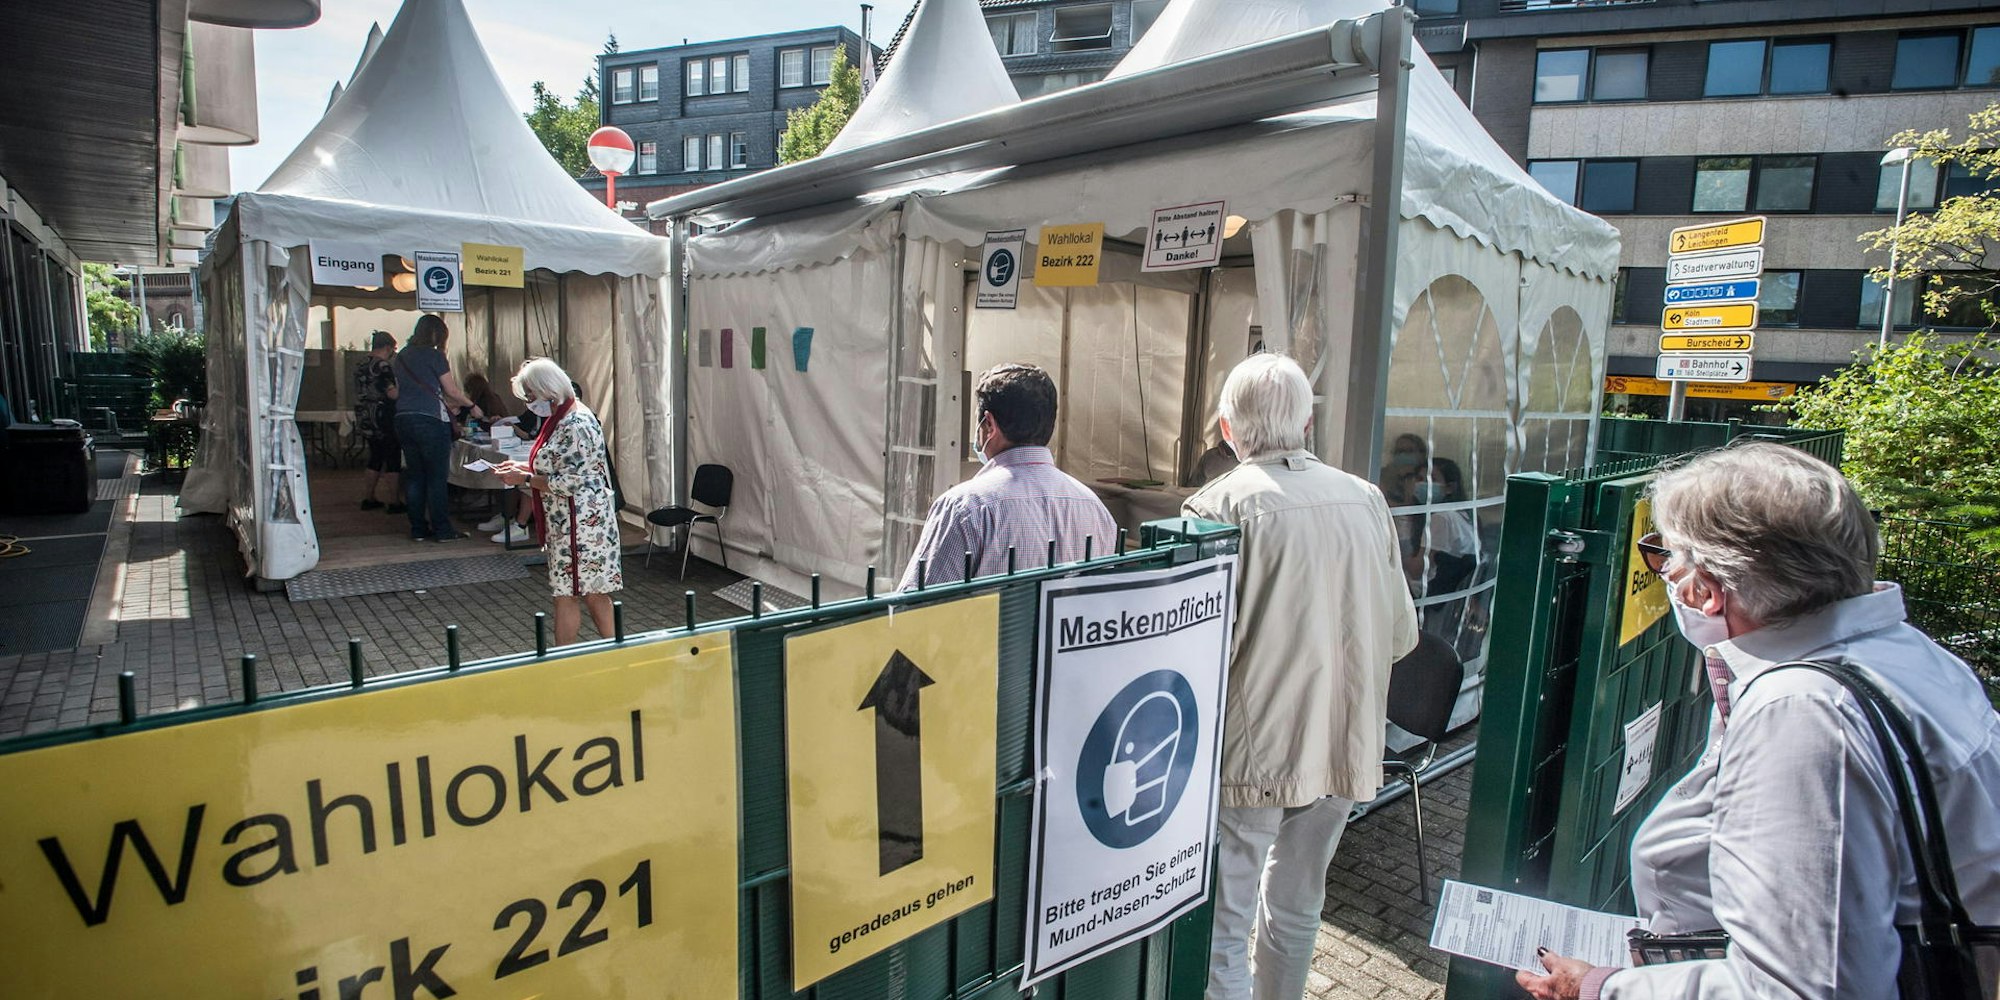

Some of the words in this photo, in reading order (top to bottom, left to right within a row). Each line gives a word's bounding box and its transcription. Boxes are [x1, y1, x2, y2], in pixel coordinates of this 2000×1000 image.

[1173, 212, 1198, 220] Abstand
[1199, 209, 1219, 217] halten
[1048, 232, 1094, 245] Wahllokal
[1689, 228, 1728, 239] Langenfeld
[1688, 238, 1728, 248] Leichlingen
[476, 254, 509, 263] Wahllokal
[1042, 256, 1074, 267] Bezirk
[1076, 255, 1094, 267] 222
[1166, 249, 1199, 261] Danke!
[318, 256, 375, 273] Eingang
[1682, 260, 1755, 274] Stadtverwaltung
[475, 267, 498, 275] Bezirk
[499, 268, 512, 276] 221
[1685, 318, 1721, 326] Stadtmitte
[1687, 338, 1731, 348] Burscheid
[1692, 359, 1729, 369] Bahnhof
[1060, 590, 1223, 648] Maskenpflicht
[37, 709, 646, 928] Wahllokal
[1045, 898, 1086, 925] Bitte
[1091, 874, 1141, 906] tragen
[1145, 861, 1167, 882] Sie
[1169, 841, 1202, 868] einen
[1049, 866, 1197, 949] Mund-Nasen-Schutz
[494, 859, 653, 980] 221
[829, 899, 921, 954] geradeaus
[926, 874, 975, 909] gehen
